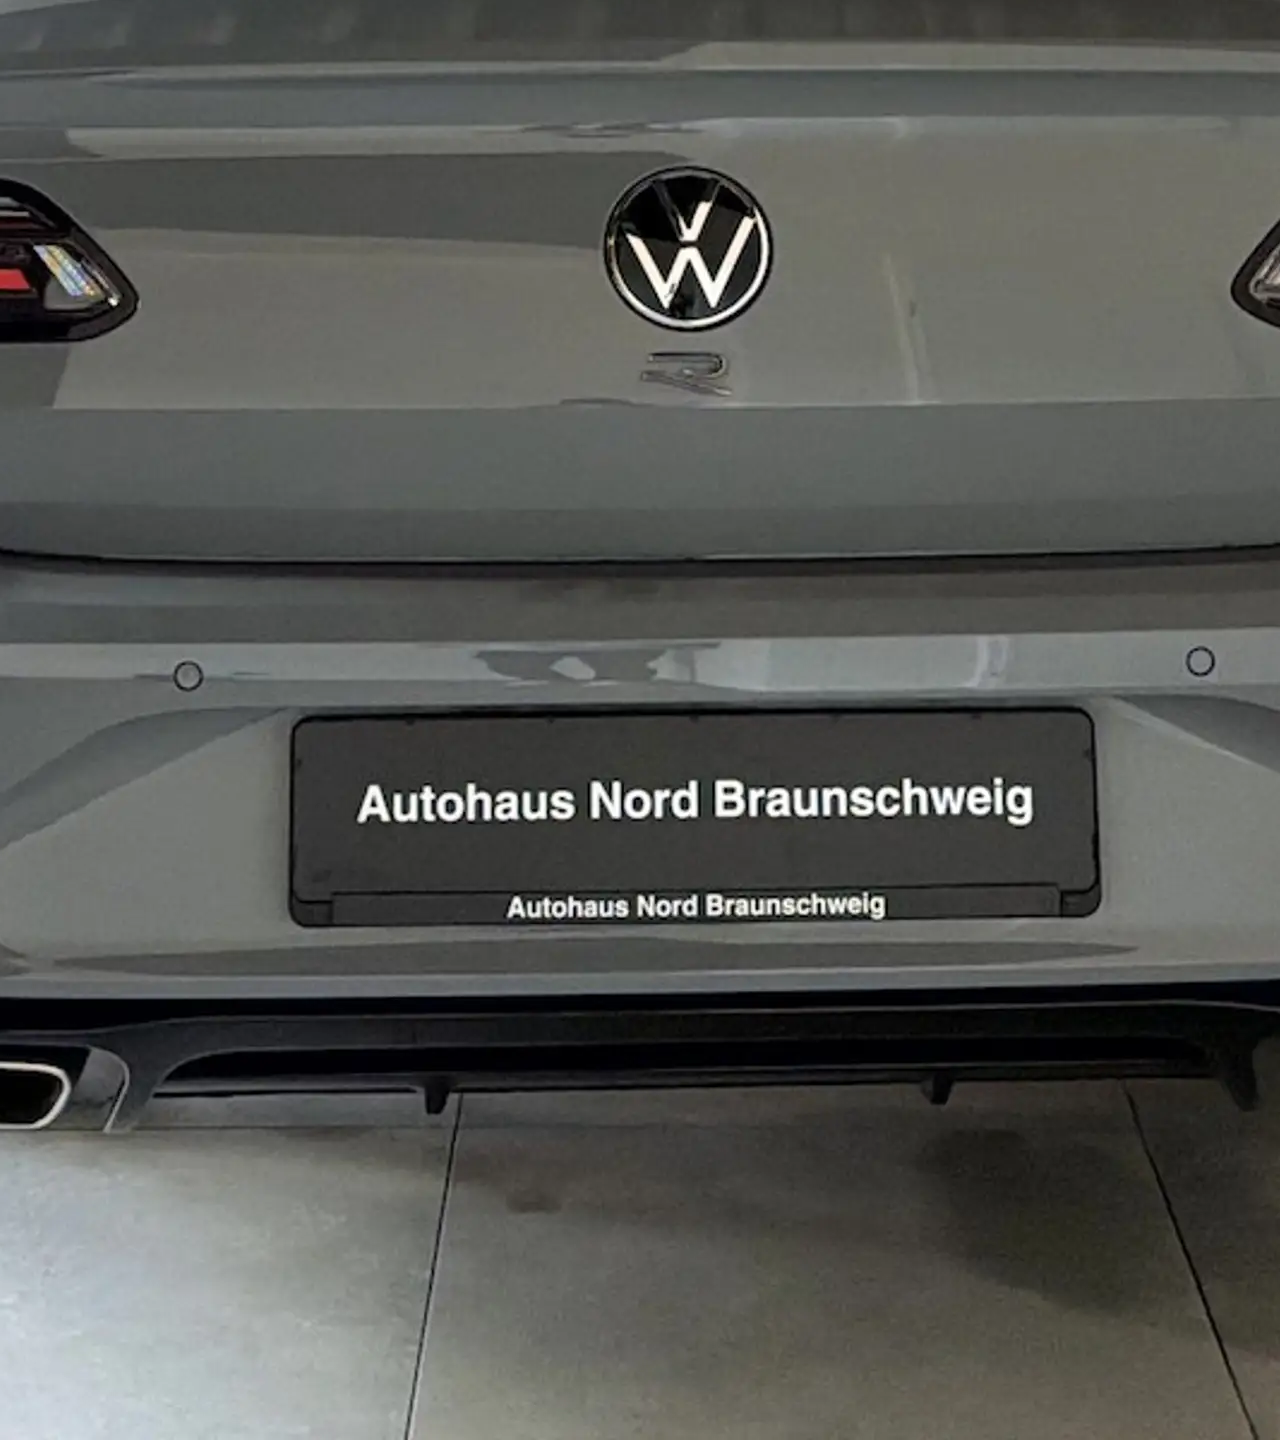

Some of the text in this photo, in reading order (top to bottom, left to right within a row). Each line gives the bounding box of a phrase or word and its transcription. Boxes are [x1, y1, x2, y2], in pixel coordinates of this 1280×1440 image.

[616, 173, 763, 313] VW
[356, 777, 1034, 827] Autohaus Nord Braunschweig
[506, 891, 887, 921] Autohaus Nord Braunschweig
